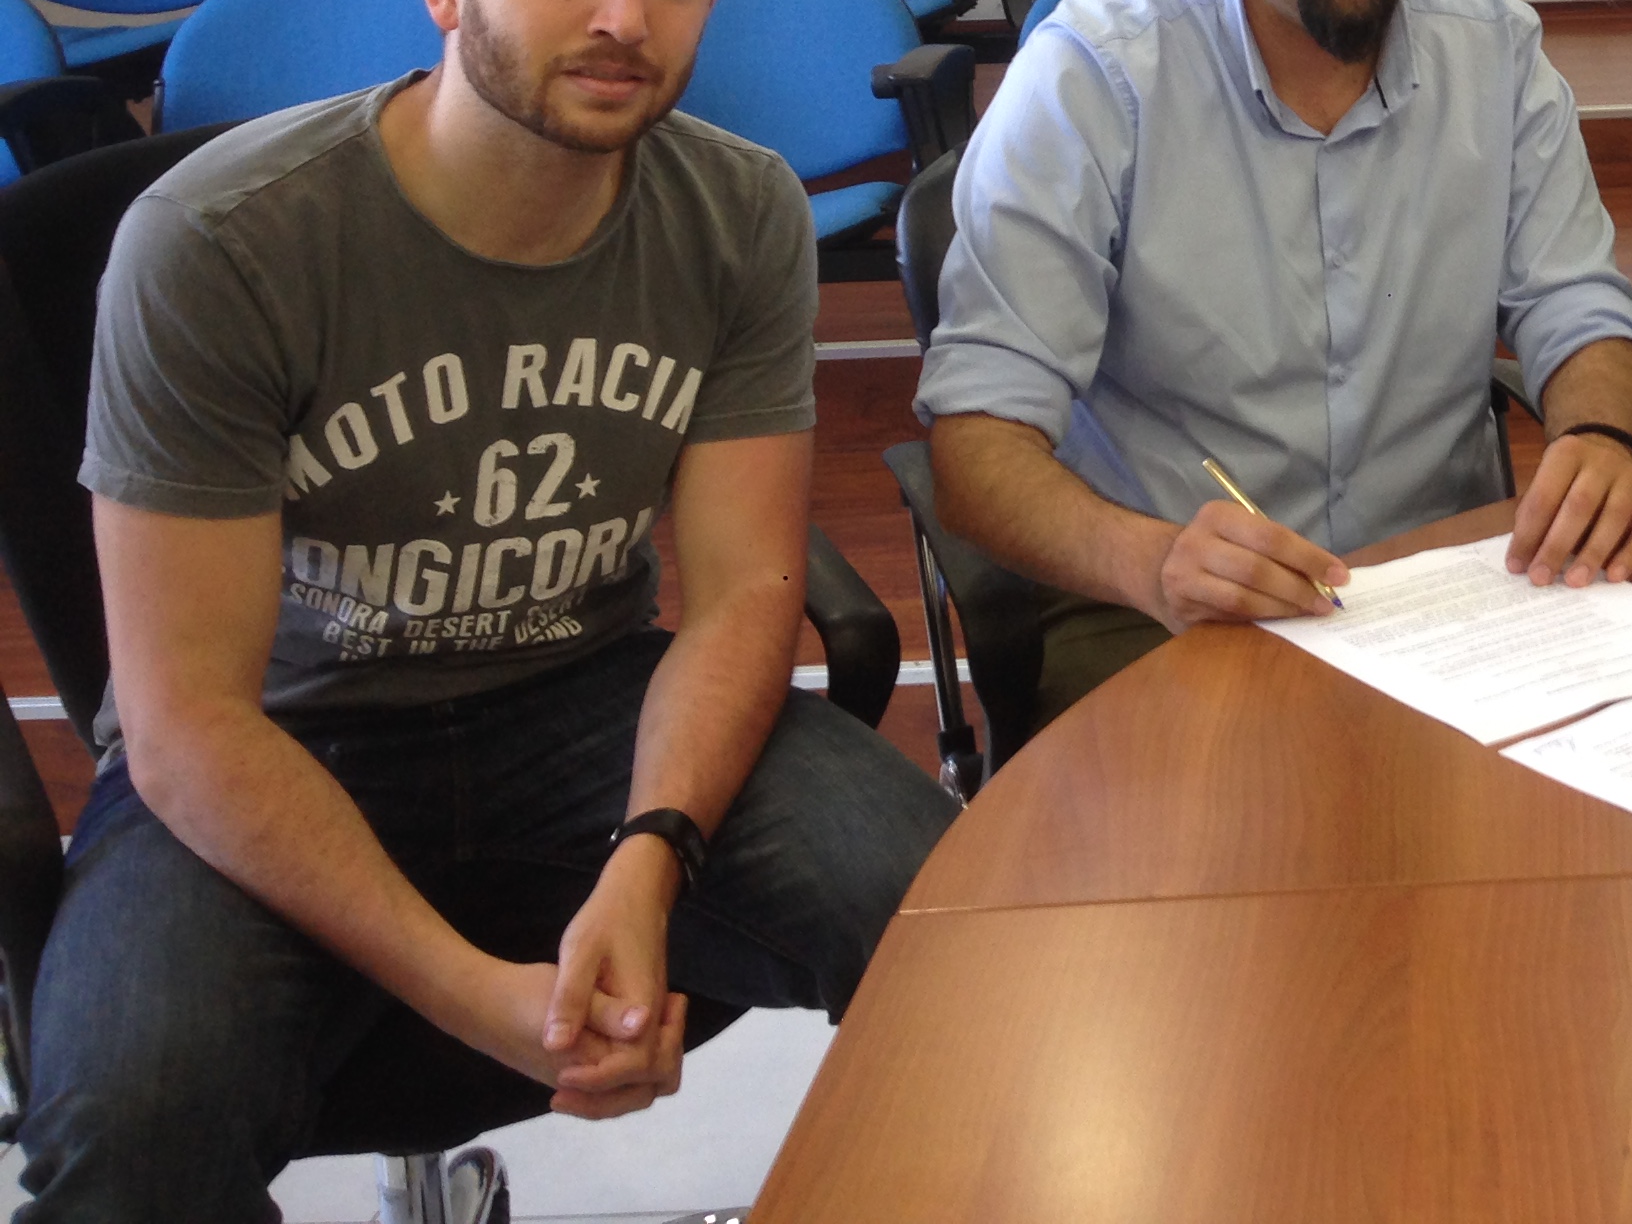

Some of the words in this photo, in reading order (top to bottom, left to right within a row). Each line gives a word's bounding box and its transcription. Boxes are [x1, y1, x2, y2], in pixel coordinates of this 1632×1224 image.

[473, 432, 577, 528] 62
[288, 506, 653, 618] ONGICOR
[289, 582, 390, 636] SONORA
[403, 609, 512, 639] DESERT
[322, 621, 393, 658] BEST
